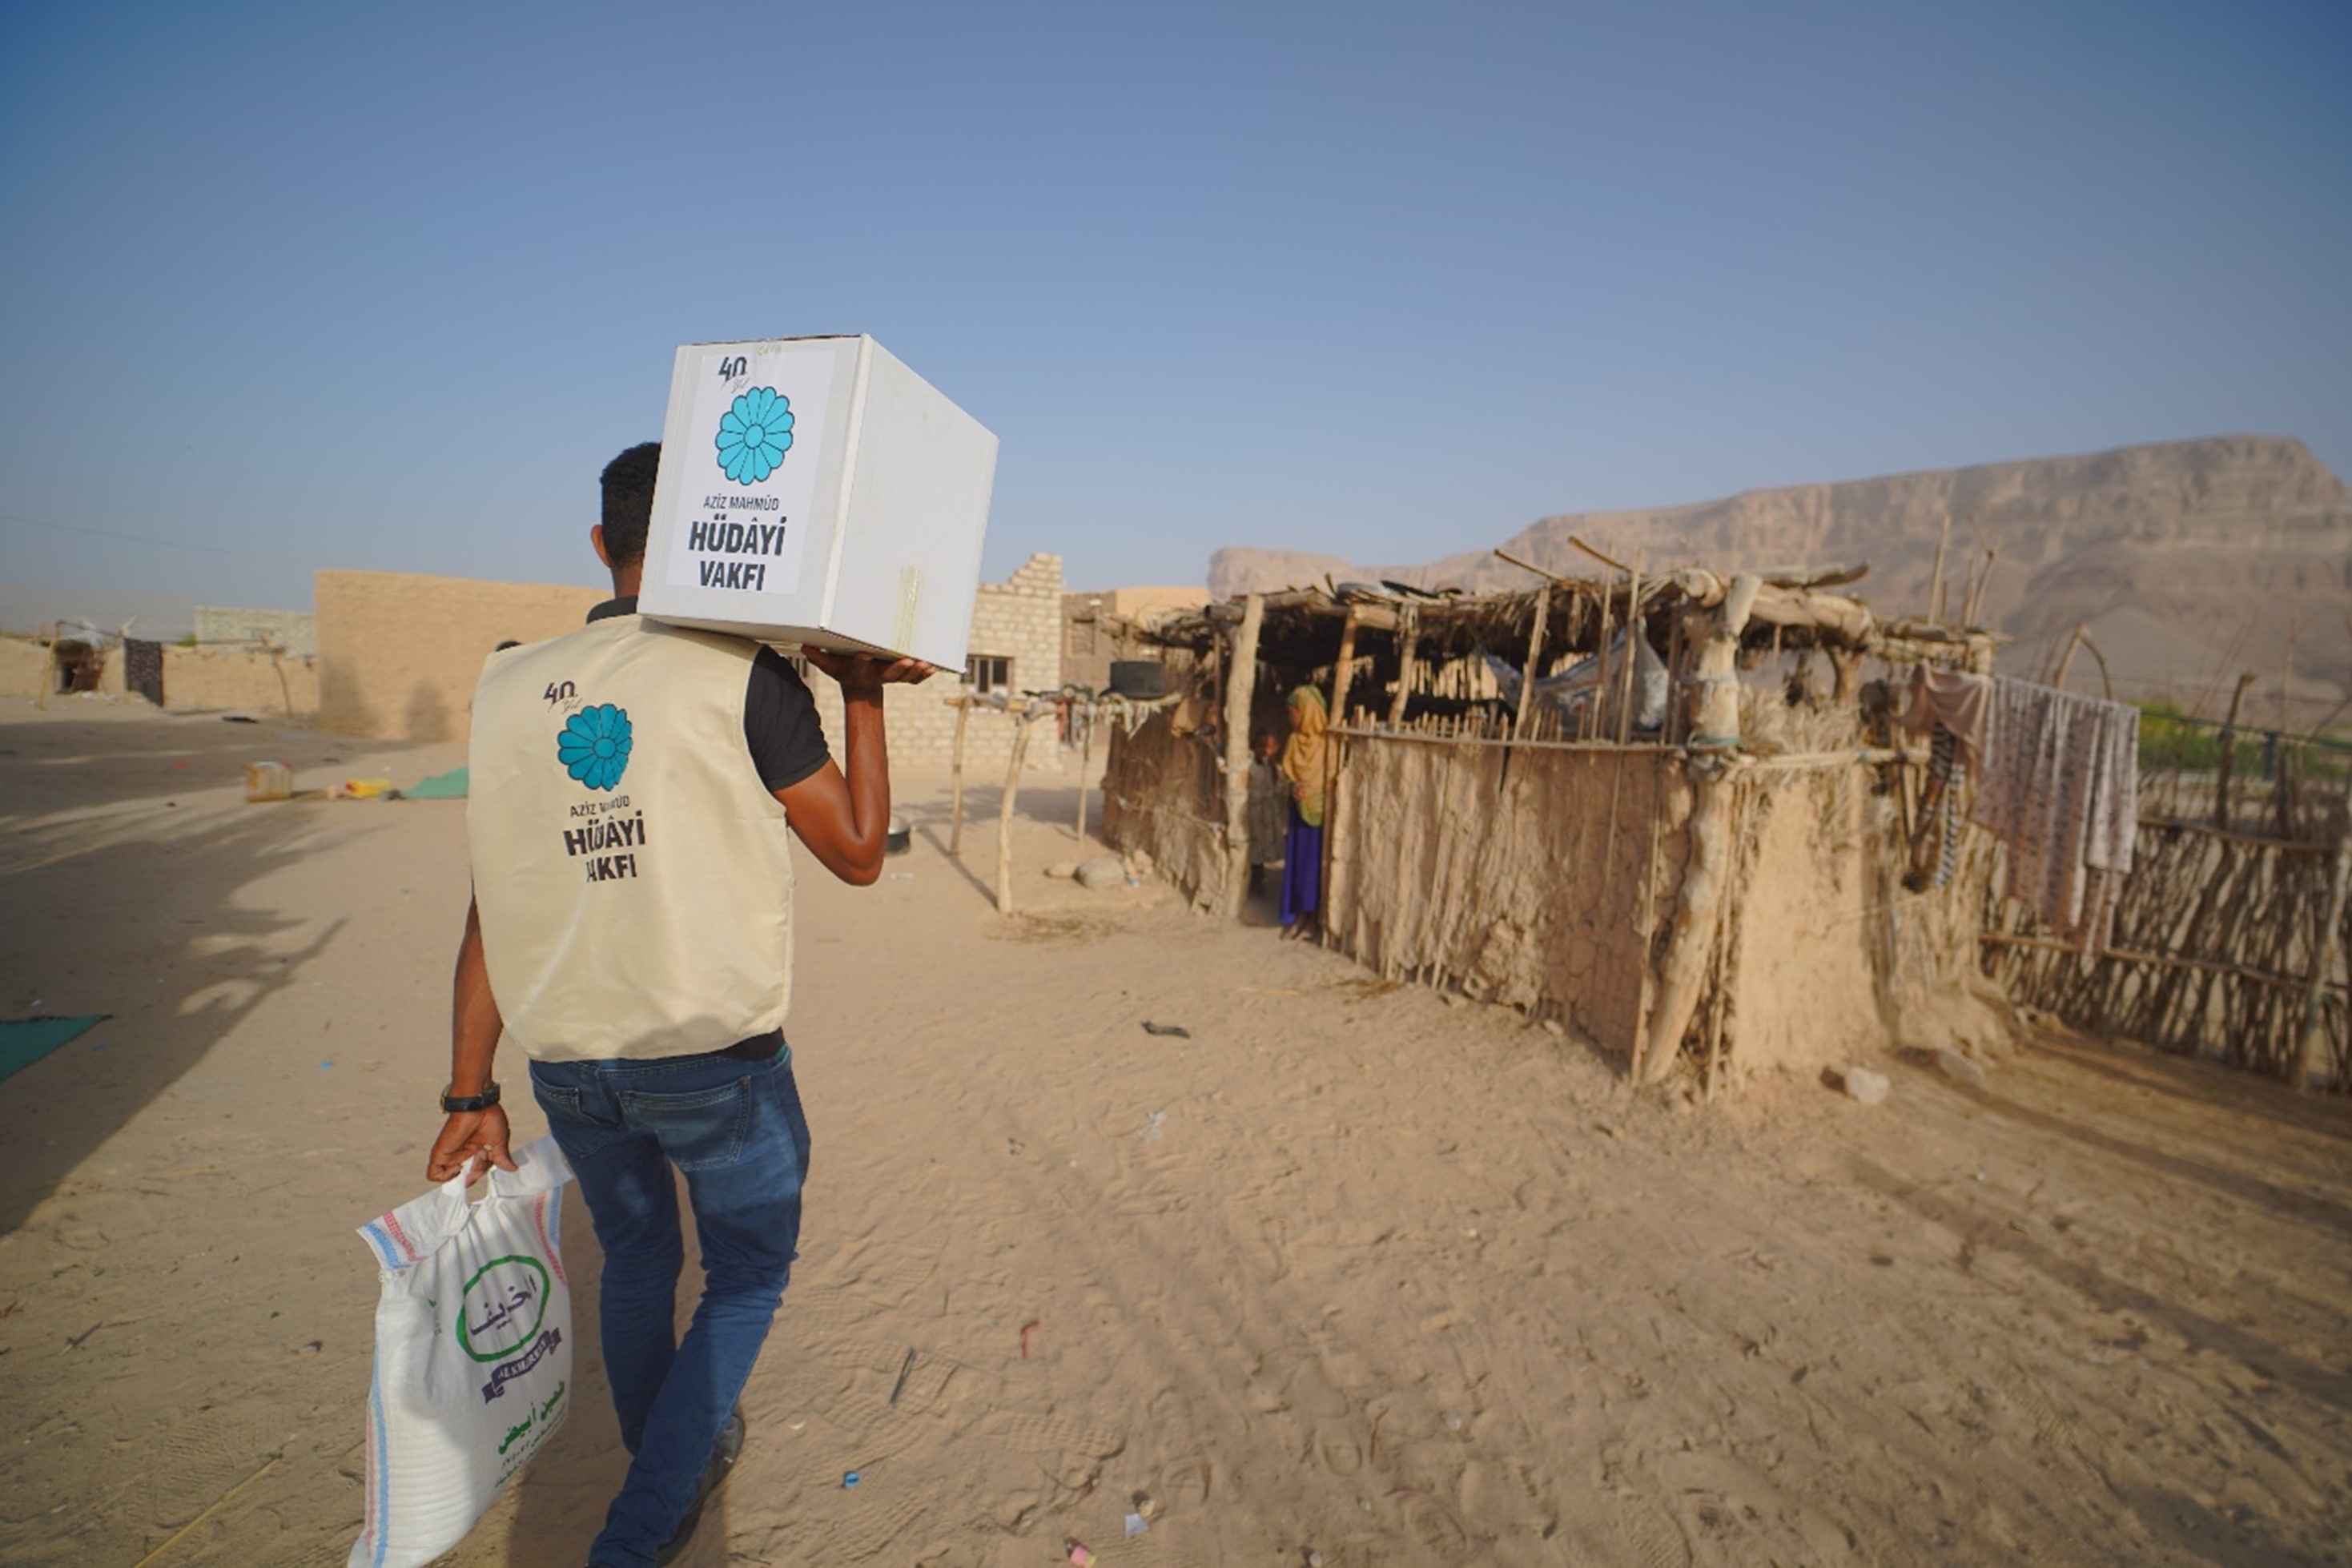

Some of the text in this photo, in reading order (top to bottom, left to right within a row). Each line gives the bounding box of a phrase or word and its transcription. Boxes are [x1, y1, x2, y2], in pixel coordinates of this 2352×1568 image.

[703, 493, 727, 509] AZİZ
[688, 513, 787, 556] HÜDÂYİ
[700, 561, 766, 591] VAKFI
[570, 801, 597, 818] AZİZ
